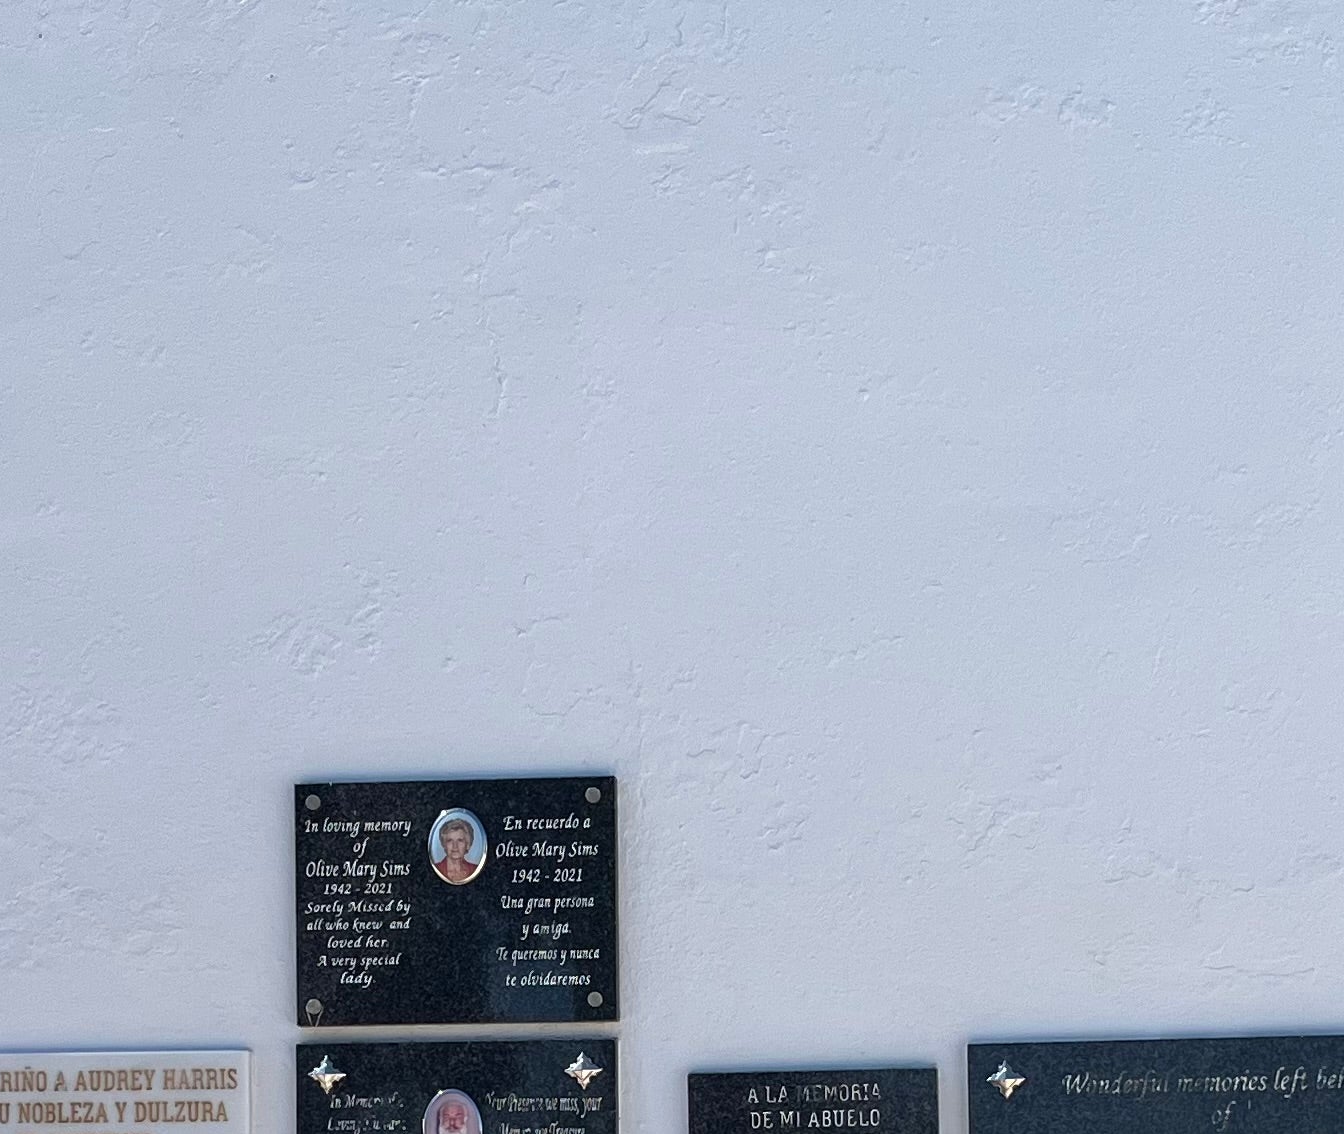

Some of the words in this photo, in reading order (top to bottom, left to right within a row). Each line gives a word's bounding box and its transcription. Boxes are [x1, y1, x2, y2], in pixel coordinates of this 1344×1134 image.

[305, 820, 318, 832] In
[323, 819, 360, 837] loving
[364, 821, 411, 836] memory
[503, 816, 522, 830] En
[527, 813, 579, 829] recuerdo
[583, 818, 590, 828] a
[352, 837, 368, 858] of
[496, 841, 528, 858] Olive
[532, 841, 566, 862] Mary
[568, 842, 598, 857] Sims
[306, 860, 338, 877] Olive
[343, 860, 377, 883] Mary
[380, 861, 410, 877] Sims
[512, 869, 540, 883] 1942
[553, 869, 582, 882] 2021
[324, 884, 351, 894] 1942
[364, 883, 391, 894] 2021
[501, 896, 523, 908] Una
[525, 898, 550, 914] gran
[554, 897, 594, 913] persona
[521, 925, 529, 940] y
[317, 956, 327, 966] A
[332, 958, 356, 970] very
[360, 955, 400, 968] special
[496, 947, 508, 960] Te
[512, 950, 557, 966] queremos
[560, 950, 567, 965] y
[570, 949, 599, 959] nunca
[506, 975, 516, 986] te
[521, 972, 590, 986] olvidaremos
[54, 1071, 68, 1092] A
[74, 1069, 155, 1091] AUDREY
[163, 1068, 237, 1090] HARRIS
[748, 1088, 759, 1103] A
[766, 1086, 788, 1103] LA
[17, 1102, 108, 1124] NOBLEZA
[115, 1102, 127, 1123] Y
[134, 1101, 228, 1123] DULZURA
[751, 1112, 773, 1128] DE
[780, 1111, 799, 1127] MI
[808, 1109, 880, 1127] ABUELO
